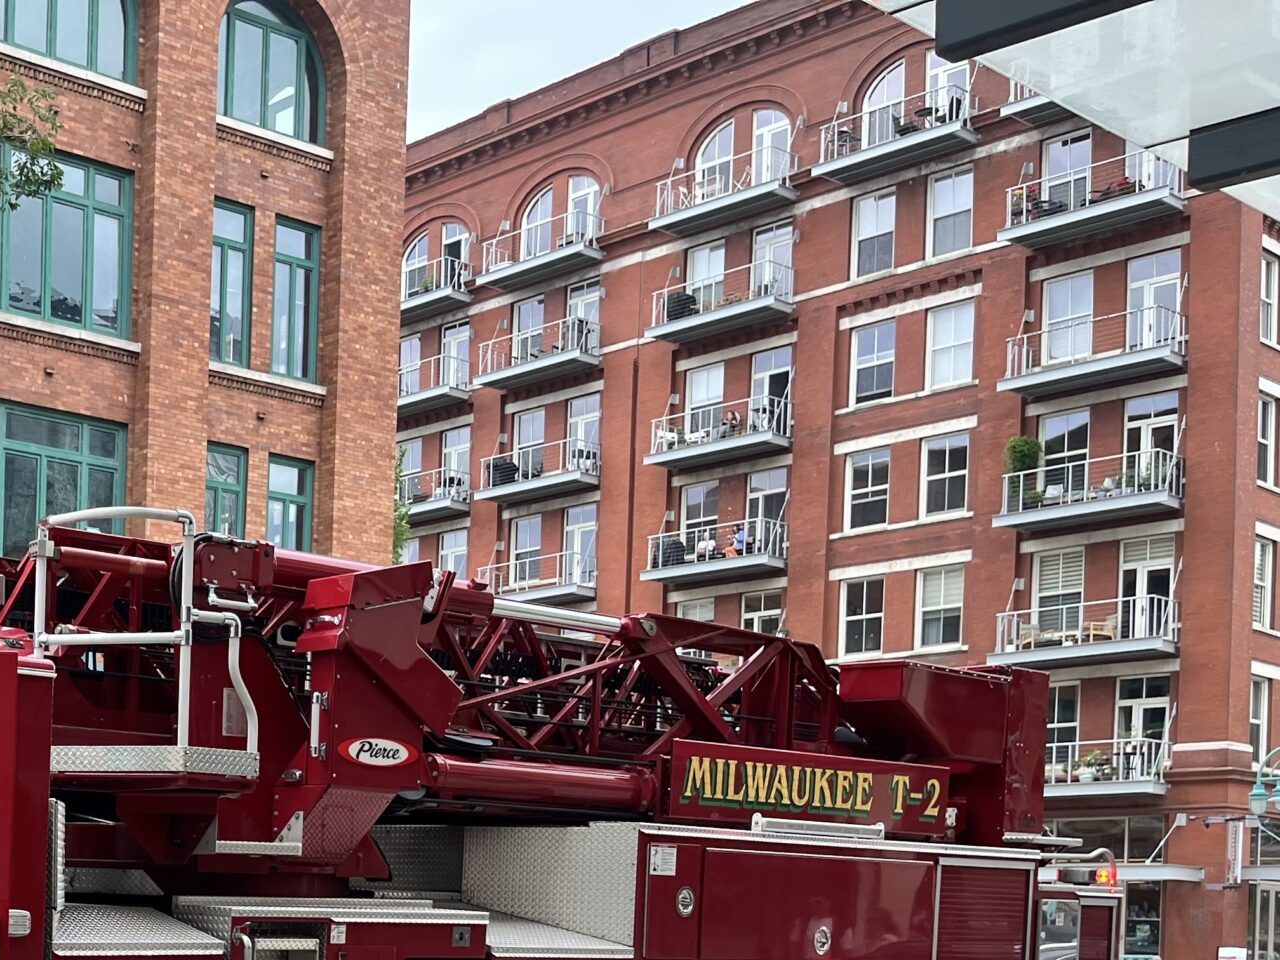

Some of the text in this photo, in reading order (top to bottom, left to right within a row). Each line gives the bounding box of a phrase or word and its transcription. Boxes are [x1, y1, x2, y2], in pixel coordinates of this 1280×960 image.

[355, 740, 401, 760] Pierce
[682, 755, 941, 819] MILWAUKEE T-2
